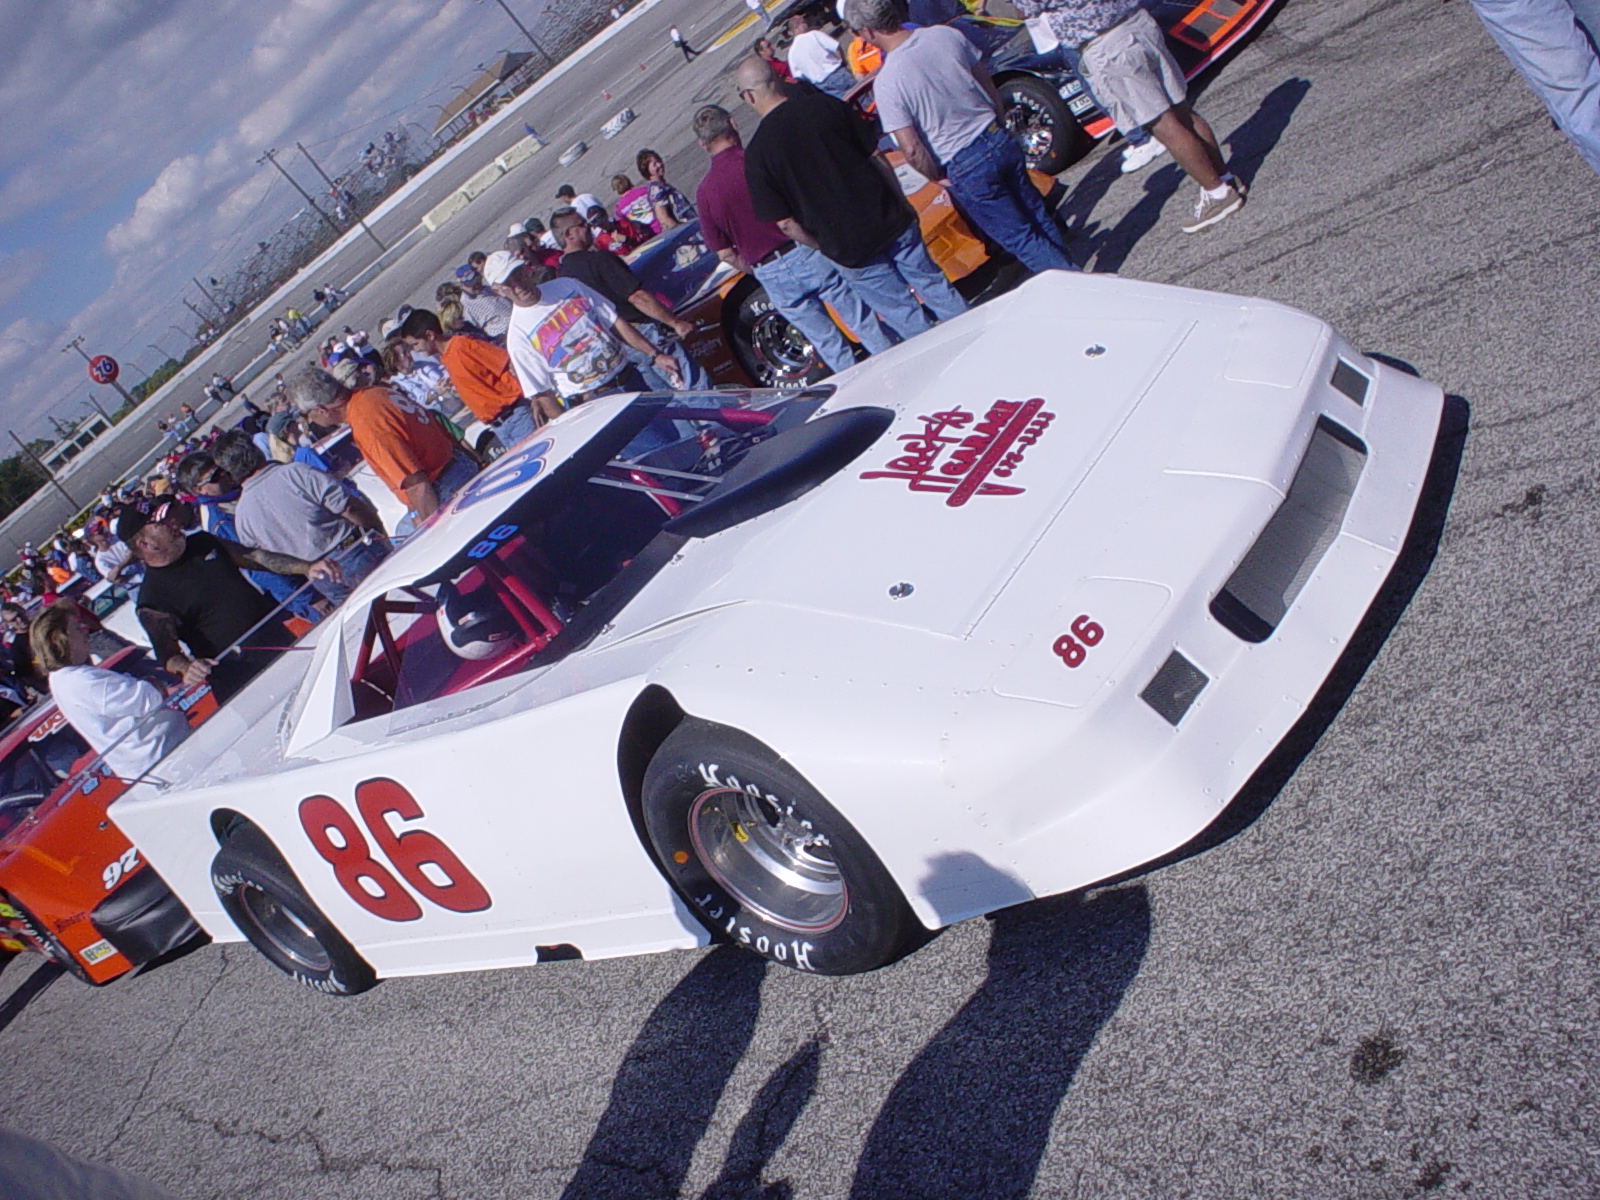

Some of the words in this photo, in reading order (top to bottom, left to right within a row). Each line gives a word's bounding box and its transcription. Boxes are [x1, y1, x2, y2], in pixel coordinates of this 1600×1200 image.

[94, 358, 114, 380] 76
[940, 399, 1024, 476] GARAGE
[466, 524, 519, 558] 86
[1052, 614, 1105, 669] 86
[297, 776, 493, 923] 86
